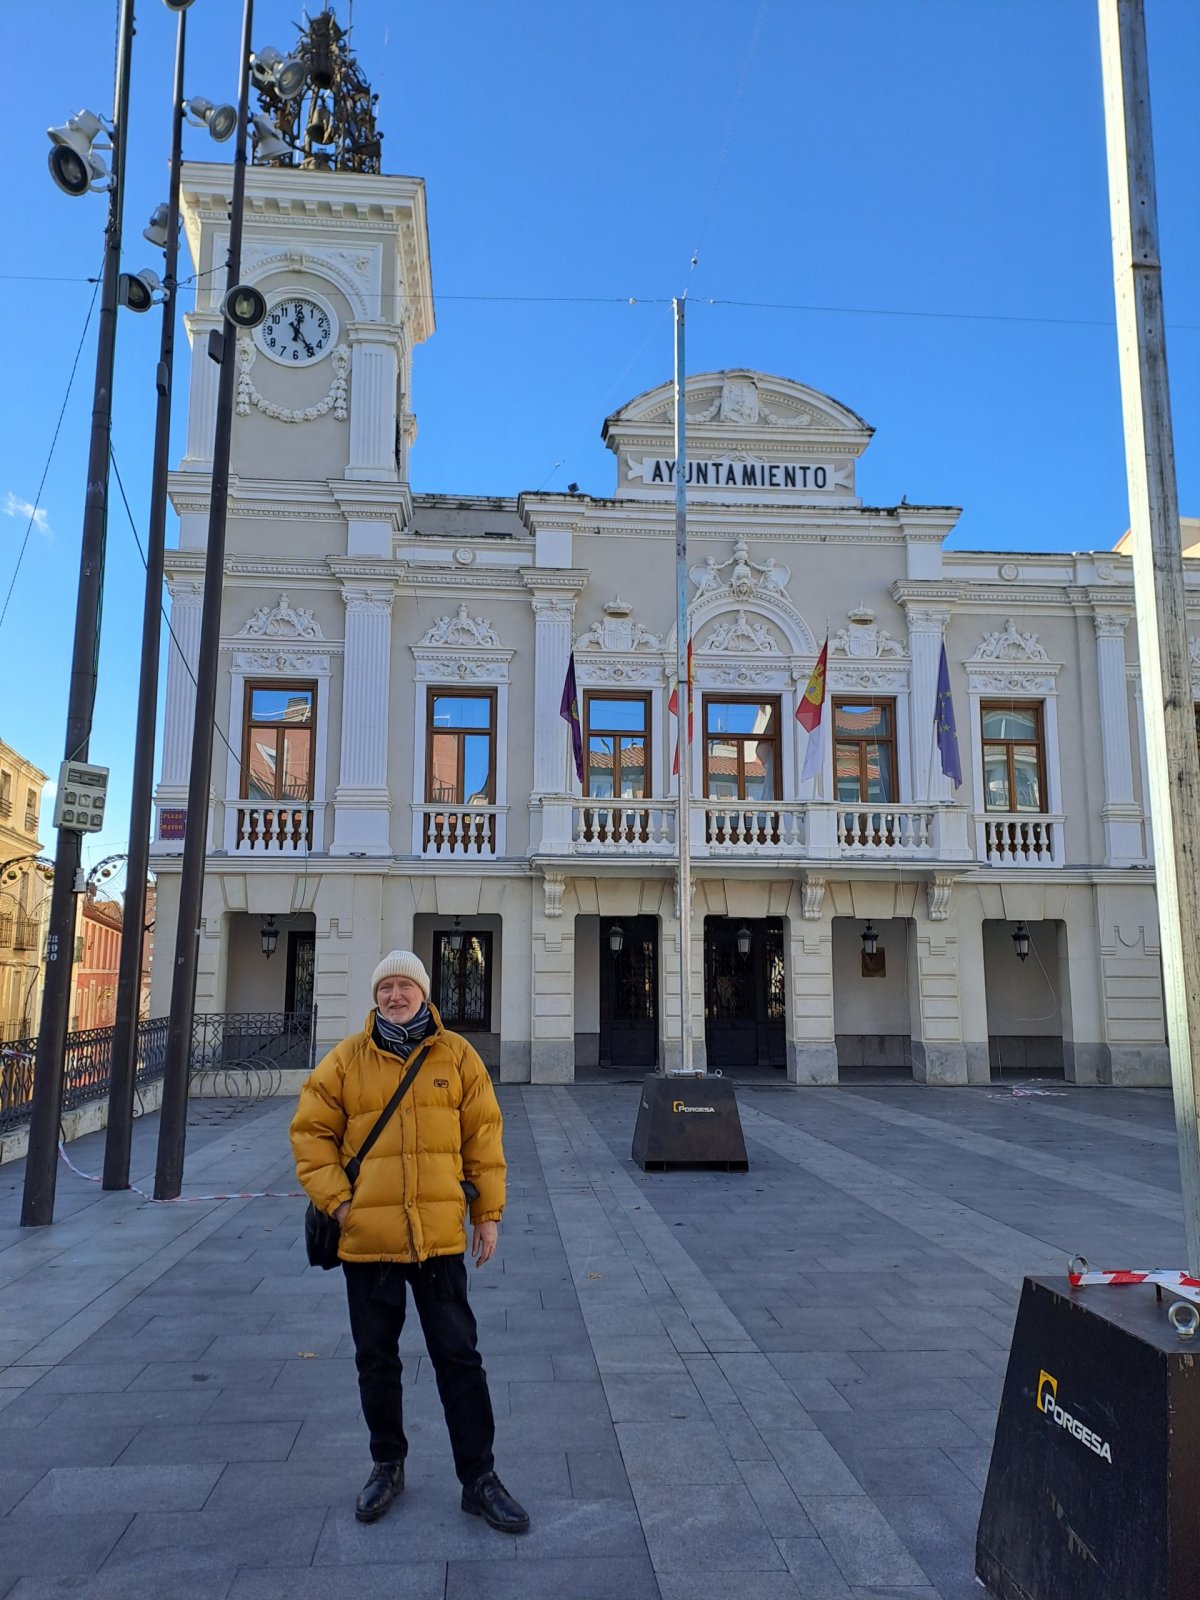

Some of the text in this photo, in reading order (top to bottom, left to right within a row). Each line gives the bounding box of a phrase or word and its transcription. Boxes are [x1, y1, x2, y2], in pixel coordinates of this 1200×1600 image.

[281, 307, 288, 317] 11
[310, 309, 314, 319] 1
[271, 314, 281, 325] 10
[317, 317, 324, 328] 2
[267, 325, 273, 336] 9
[321, 329, 328, 339] 3
[270, 337, 276, 348] 8
[316, 340, 323, 349] 4
[280, 345, 287, 356] 7
[292, 350, 299, 360] 6
[652, 460, 827, 488] AYUNTAMIENTO
[1044, 1393, 1112, 1464] PORGESA
